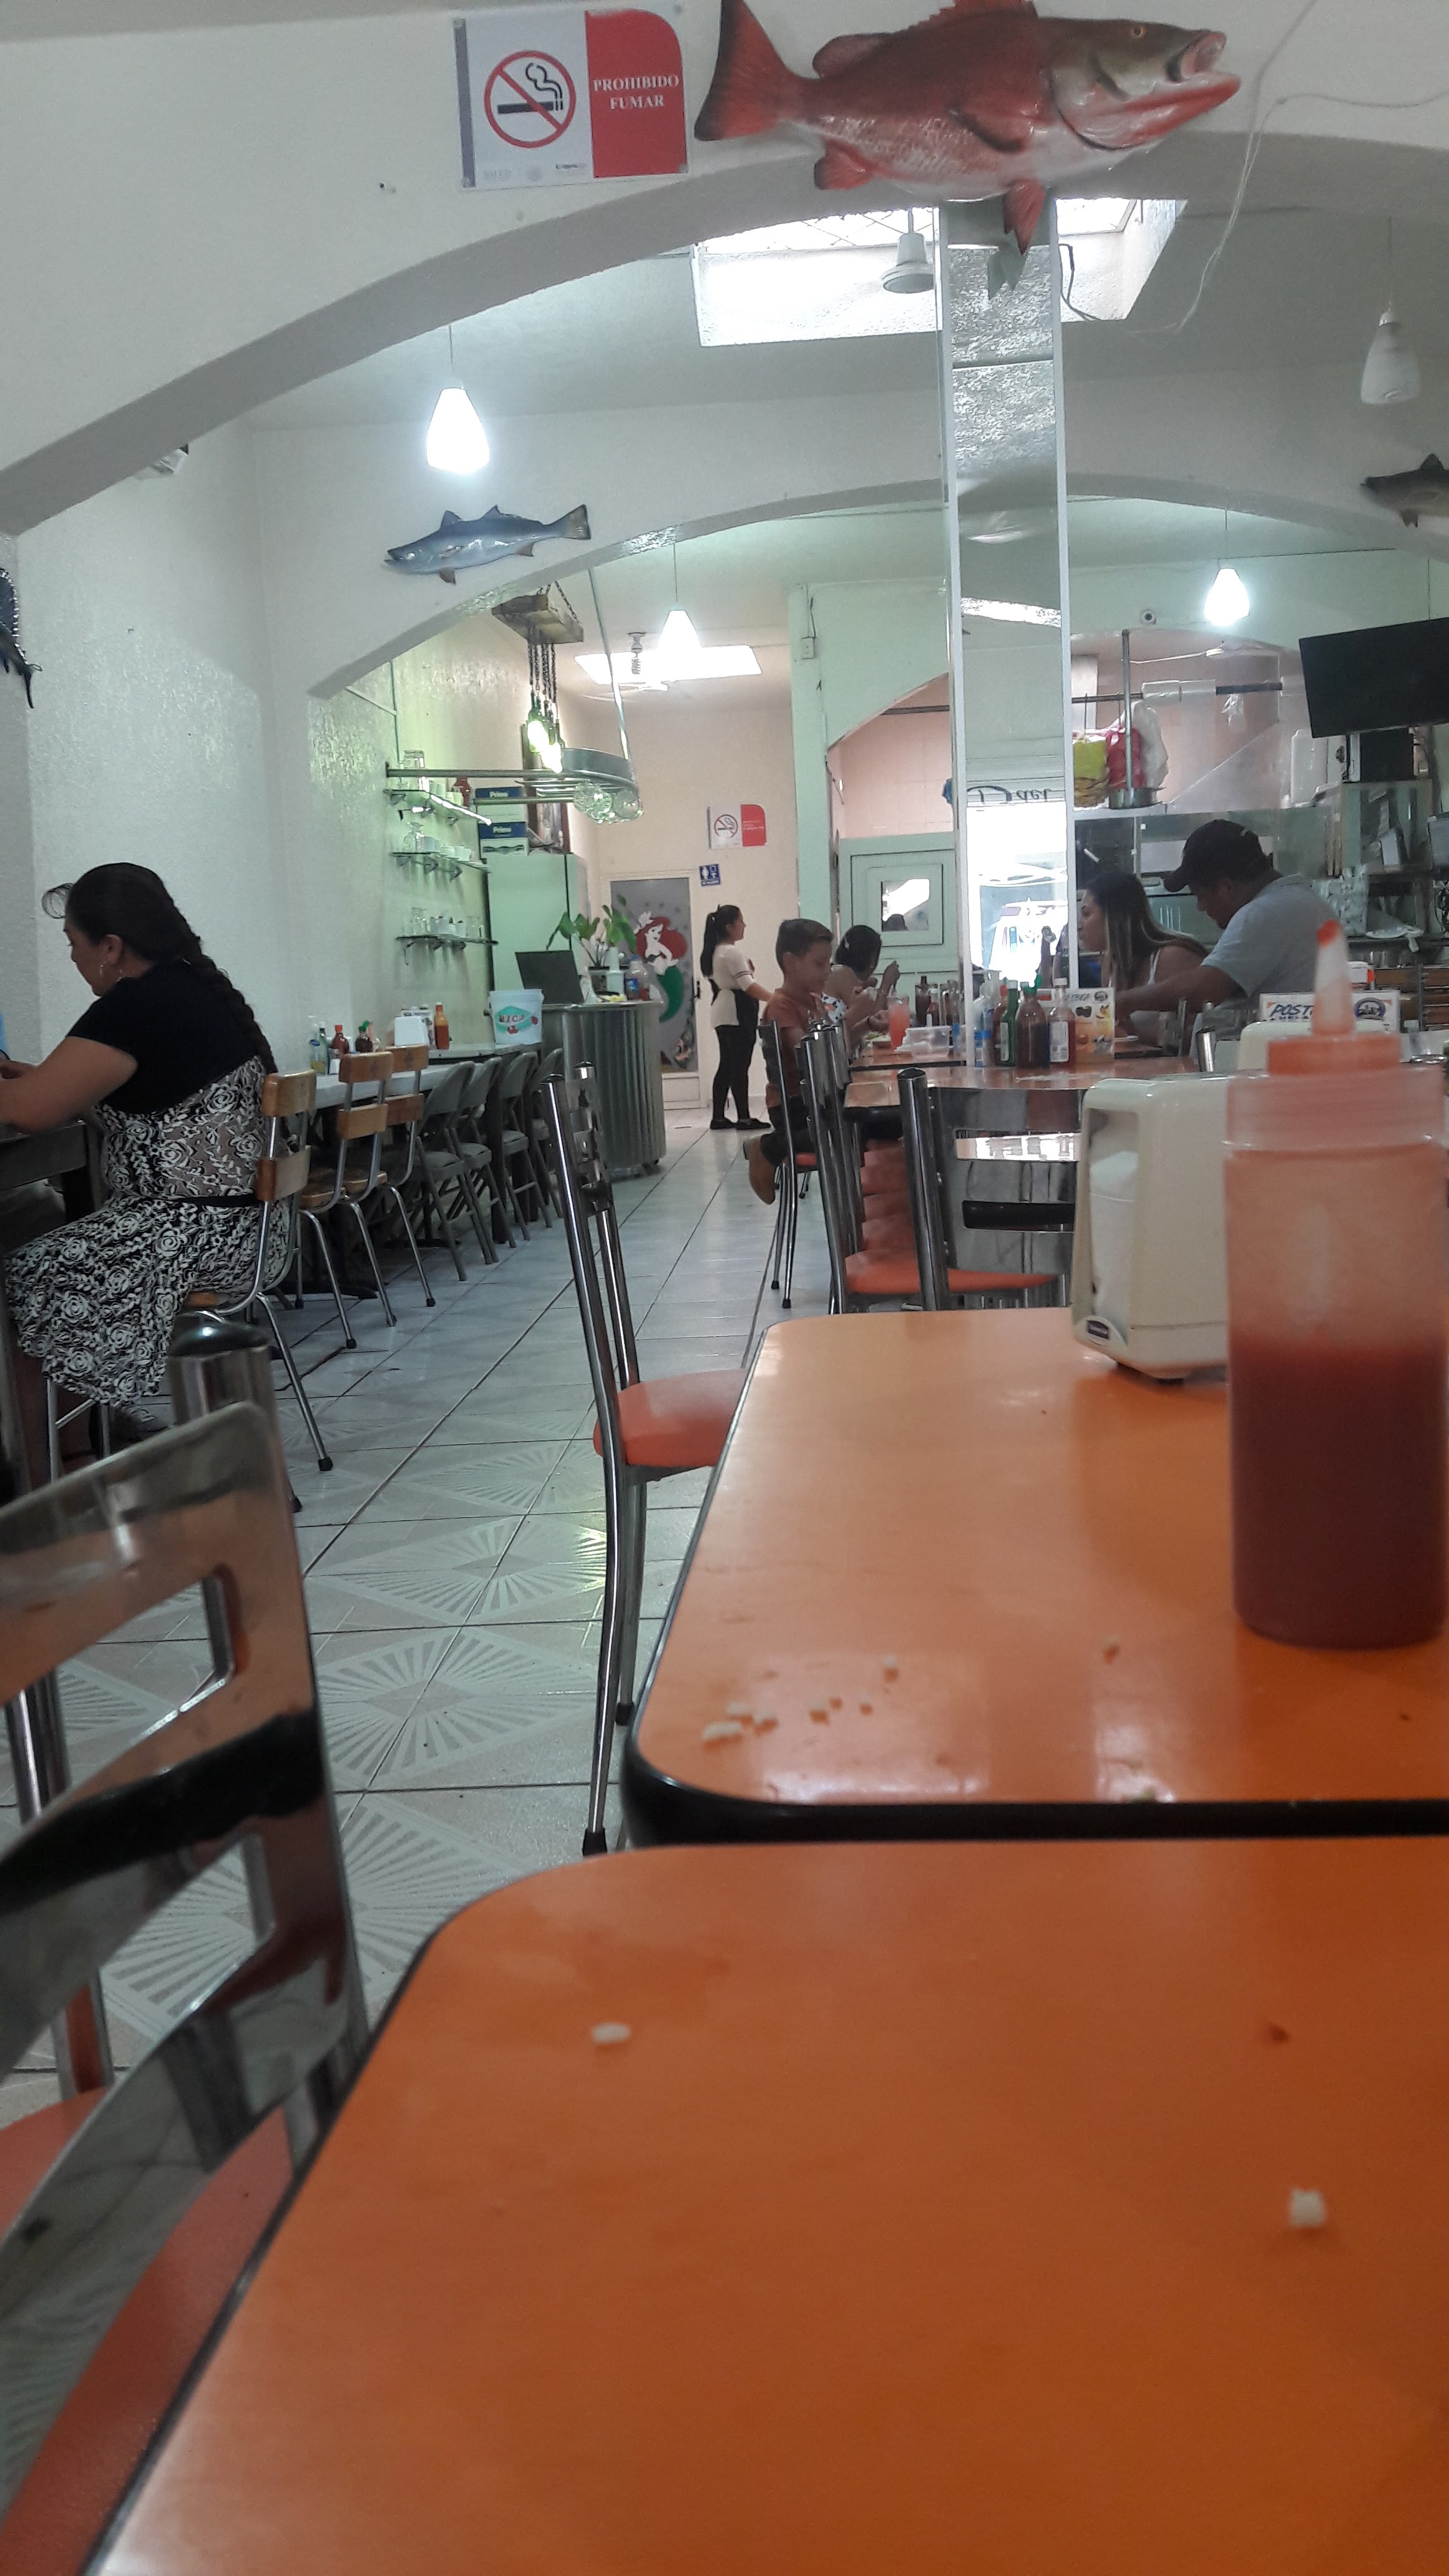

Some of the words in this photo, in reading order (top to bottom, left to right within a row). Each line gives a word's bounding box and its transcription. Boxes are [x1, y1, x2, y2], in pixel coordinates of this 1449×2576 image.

[593, 75, 680, 92] PROHIBIDO
[610, 94, 664, 110] FUMAR
[1269, 1003, 1314, 1017] POST
